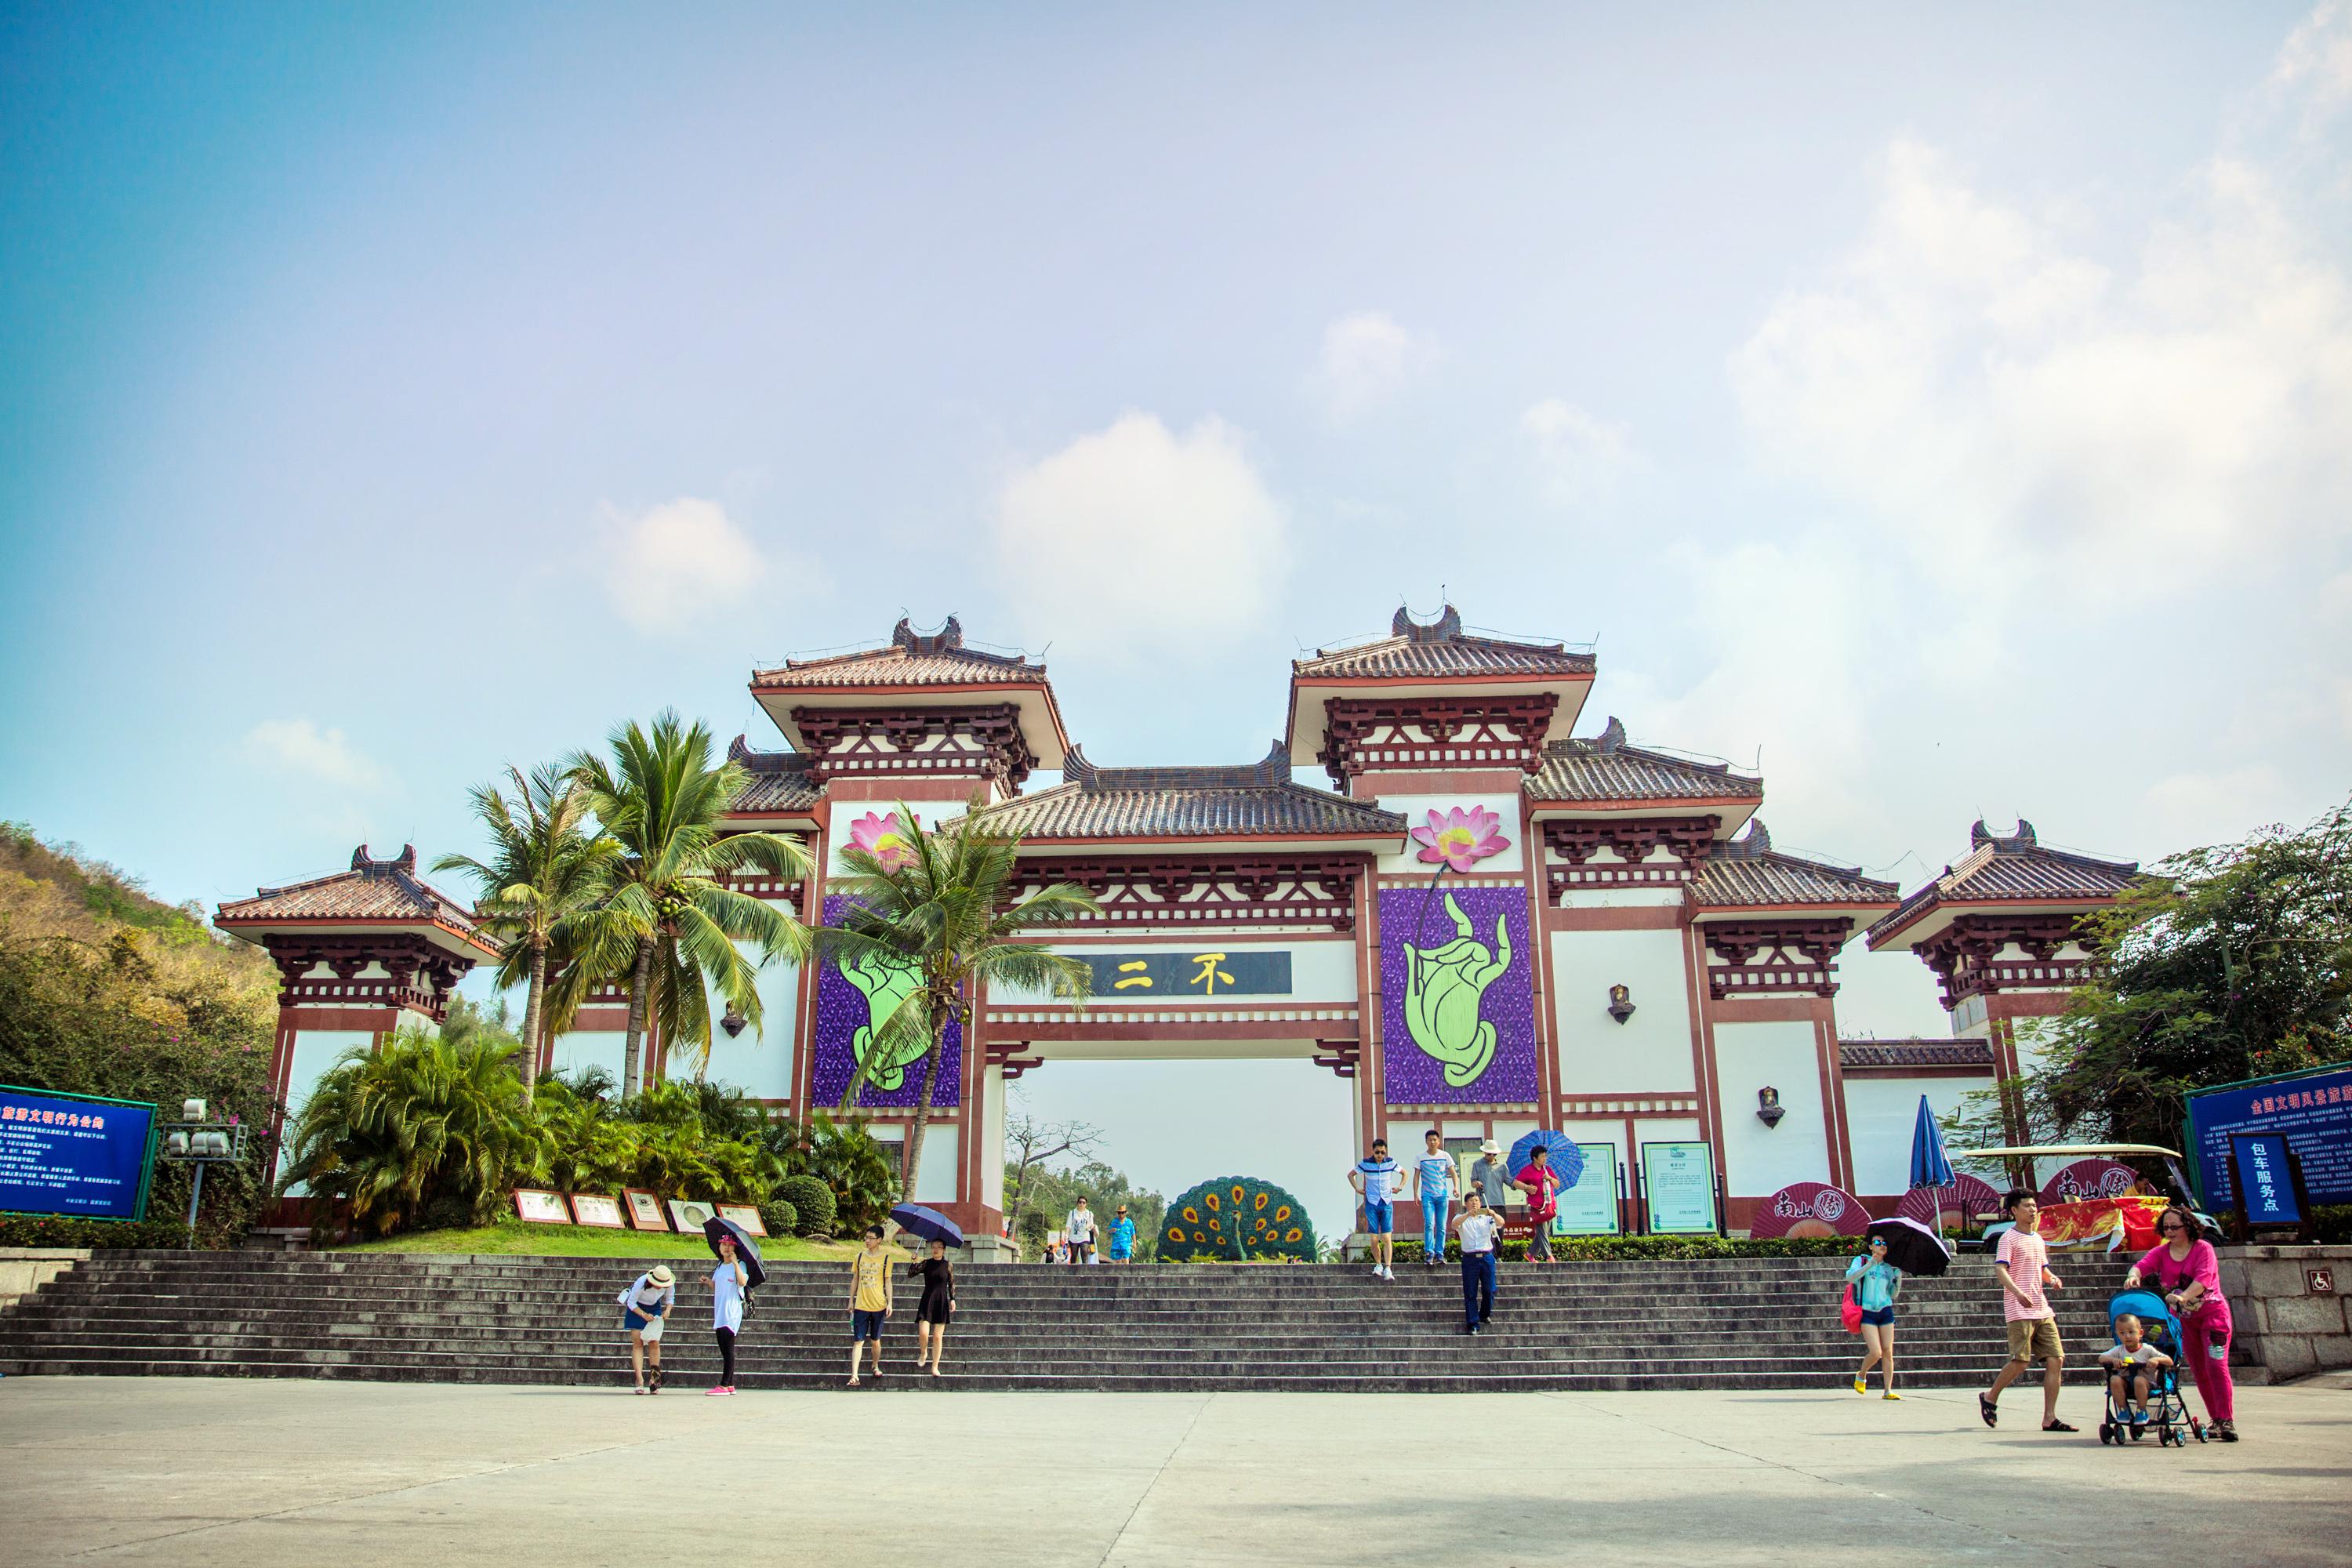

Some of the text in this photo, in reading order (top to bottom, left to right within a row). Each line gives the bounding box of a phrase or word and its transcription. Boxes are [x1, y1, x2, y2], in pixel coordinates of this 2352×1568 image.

[2251, 1143, 2280, 1212] 包车服务点
